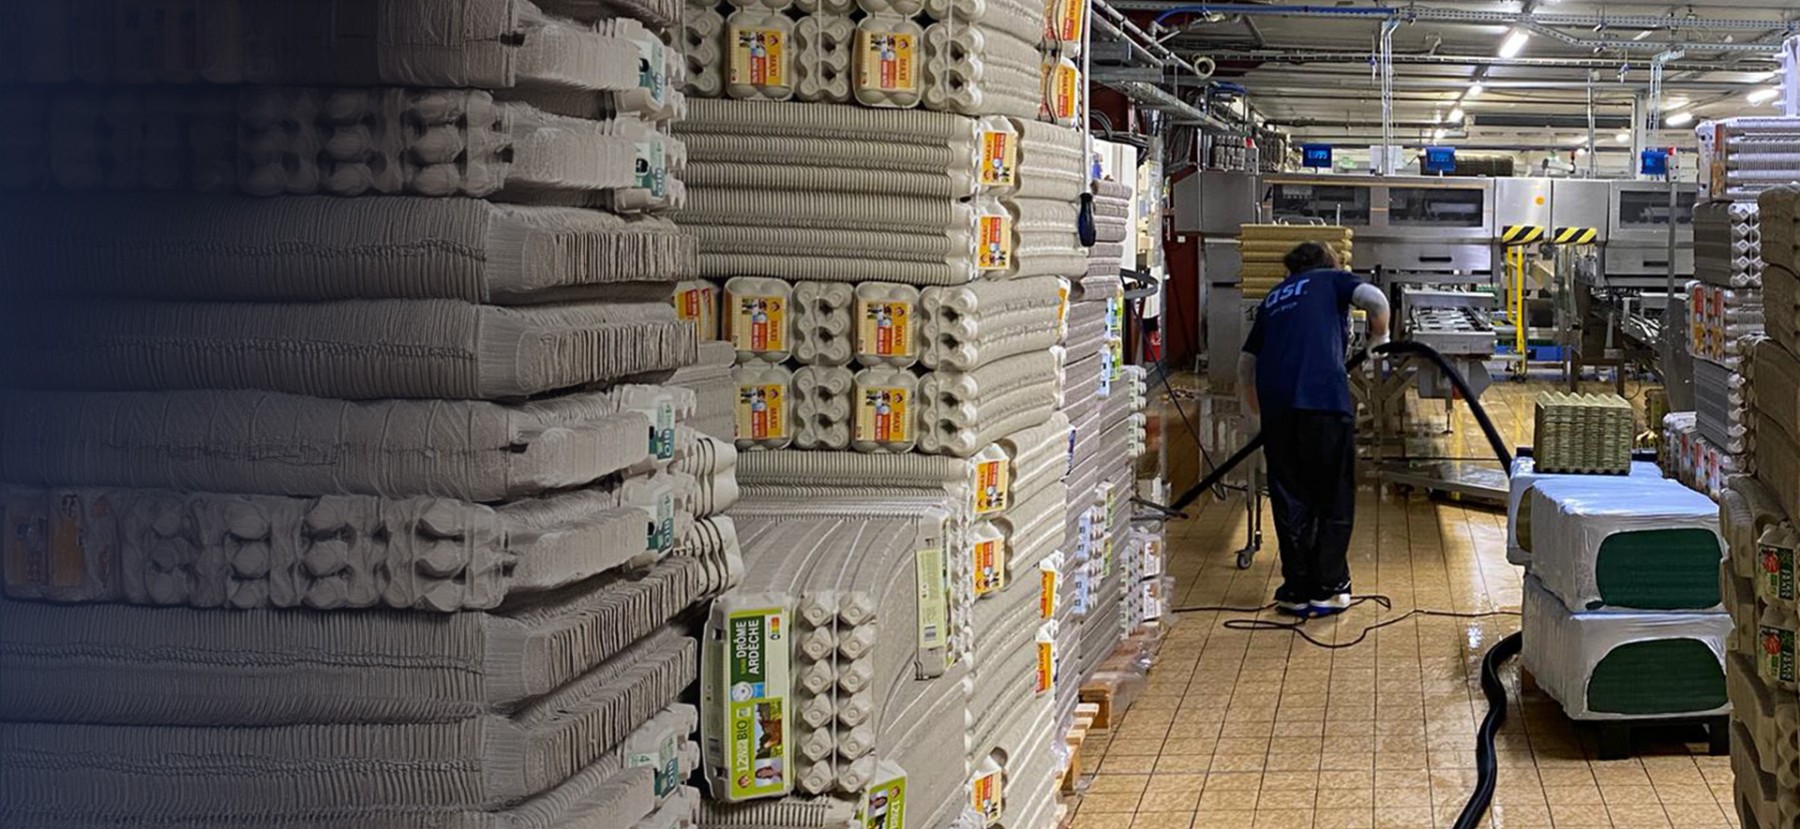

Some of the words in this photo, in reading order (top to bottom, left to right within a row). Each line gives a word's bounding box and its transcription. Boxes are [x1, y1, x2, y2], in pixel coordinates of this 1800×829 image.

[769, 55, 777, 77] MAXI
[770, 320, 778, 341] MAXI
[770, 407, 778, 428] MAXI
[893, 412, 901, 432] MAXI
[733, 621, 746, 658] DRÔME
[745, 620, 759, 675] ARDÈCHE
